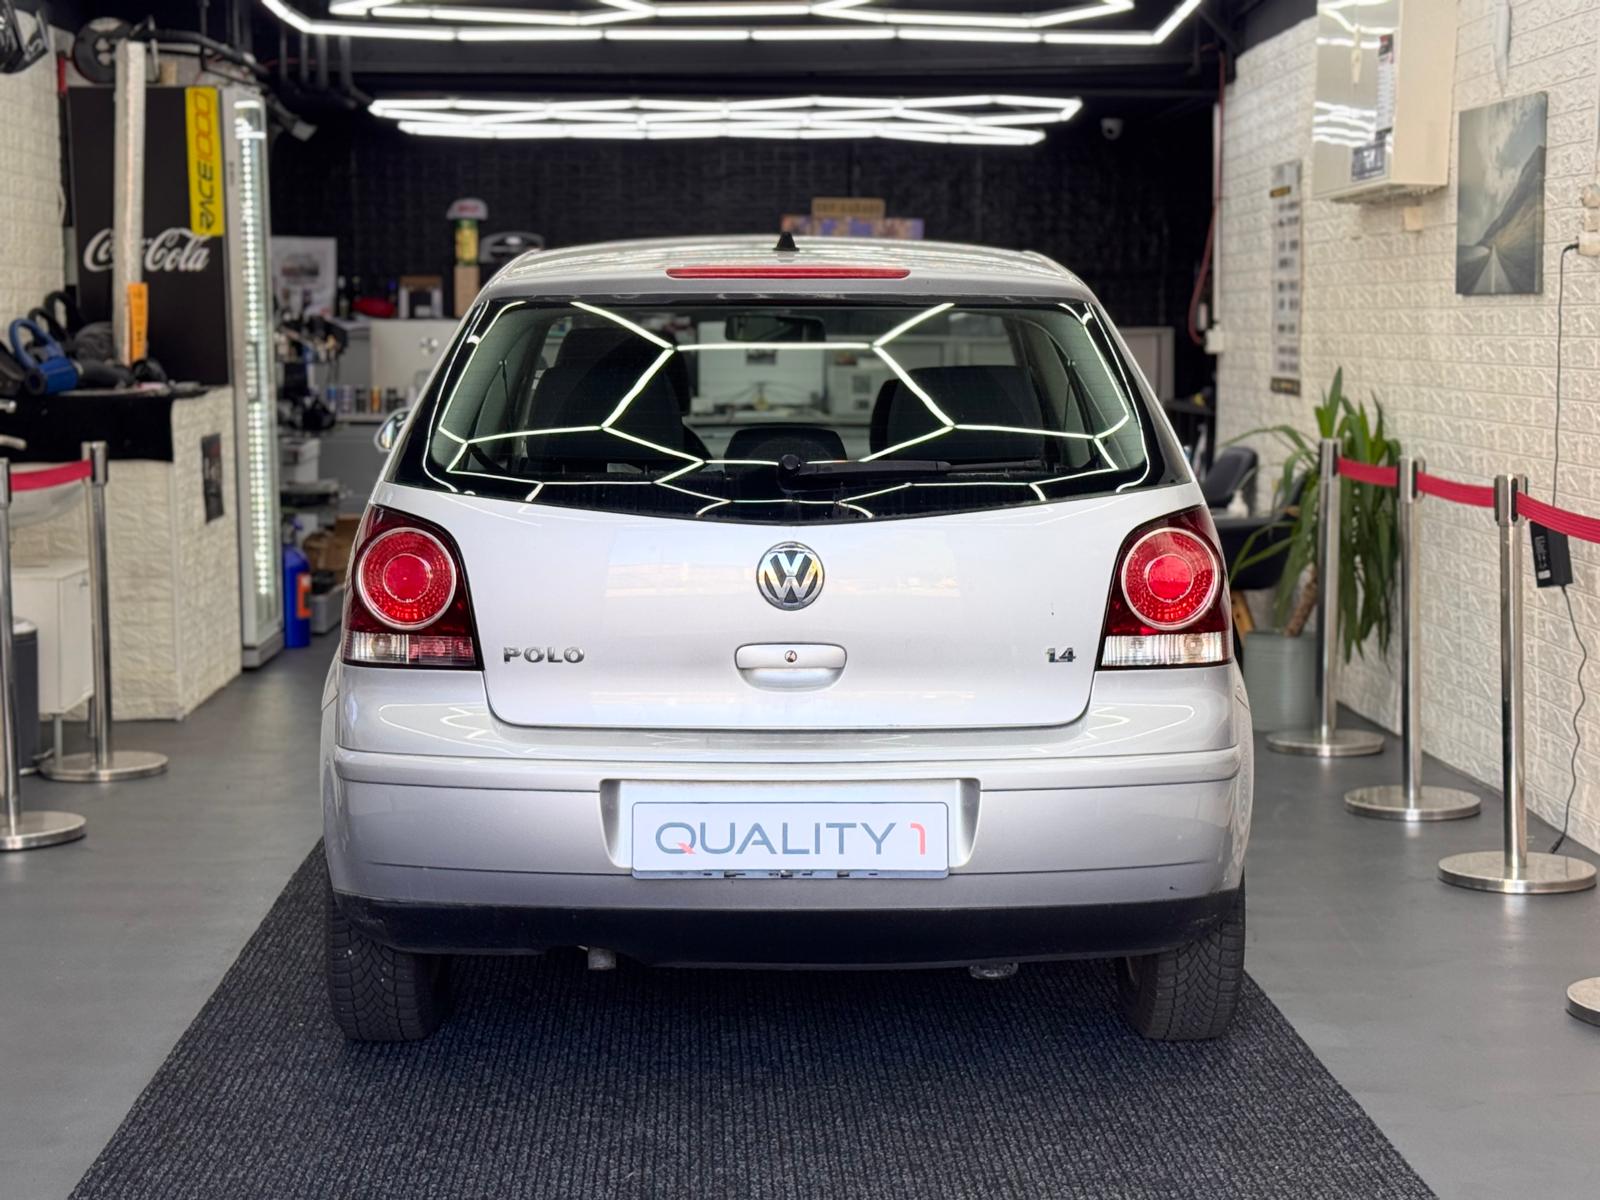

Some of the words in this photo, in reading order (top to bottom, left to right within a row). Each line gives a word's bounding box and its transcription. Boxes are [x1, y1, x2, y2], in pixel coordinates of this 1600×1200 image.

[503, 646, 585, 664] POLO
[655, 822, 897, 855] QUALITY
[910, 823, 926, 855] 1
